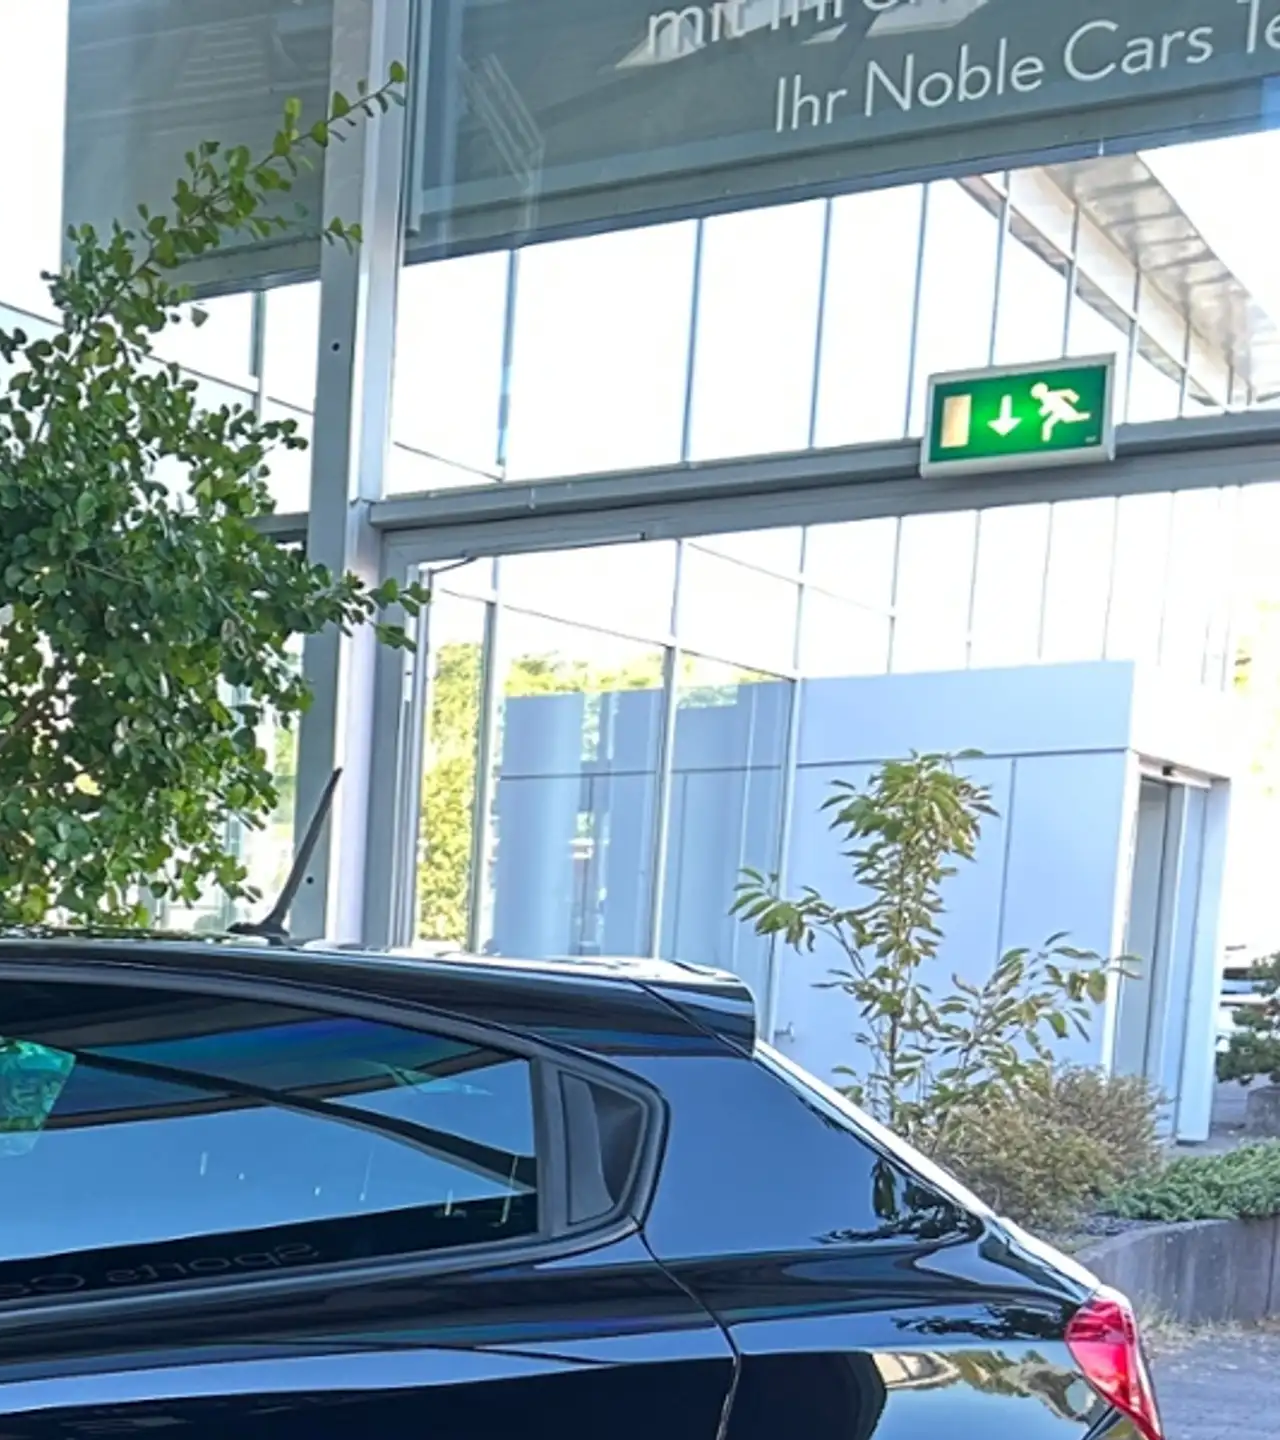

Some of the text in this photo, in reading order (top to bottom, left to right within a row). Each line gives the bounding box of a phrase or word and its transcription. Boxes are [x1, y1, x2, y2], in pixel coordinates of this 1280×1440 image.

[775, 73, 848, 133] Ihr
[863, 37, 1045, 118] Noble
[1063, 19, 1215, 82] Cars
